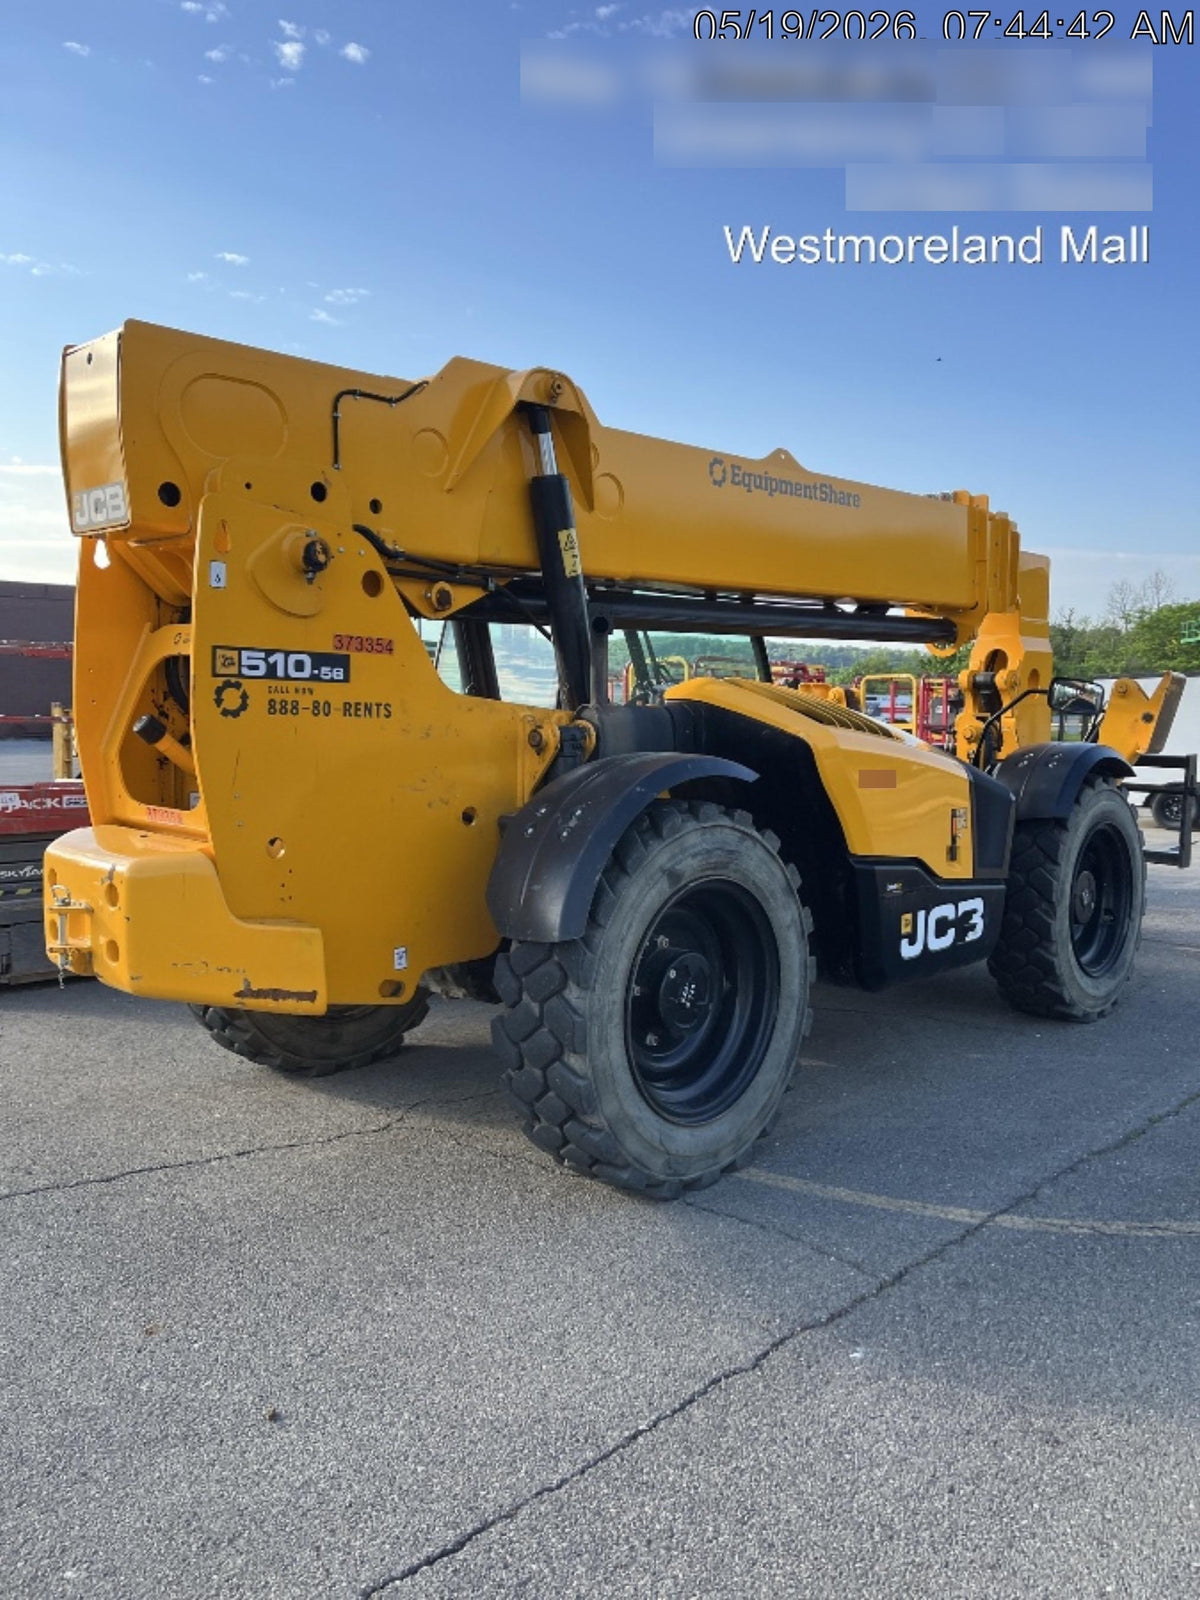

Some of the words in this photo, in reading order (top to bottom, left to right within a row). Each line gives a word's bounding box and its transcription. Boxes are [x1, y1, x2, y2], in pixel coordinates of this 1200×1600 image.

[730, 463, 861, 508] EquipmentShare
[75, 484, 127, 526] JCB
[333, 634, 395, 655] 373354
[267, 698, 392, 719] 888-80-RENTS
[0, 796, 62, 813] JACK
